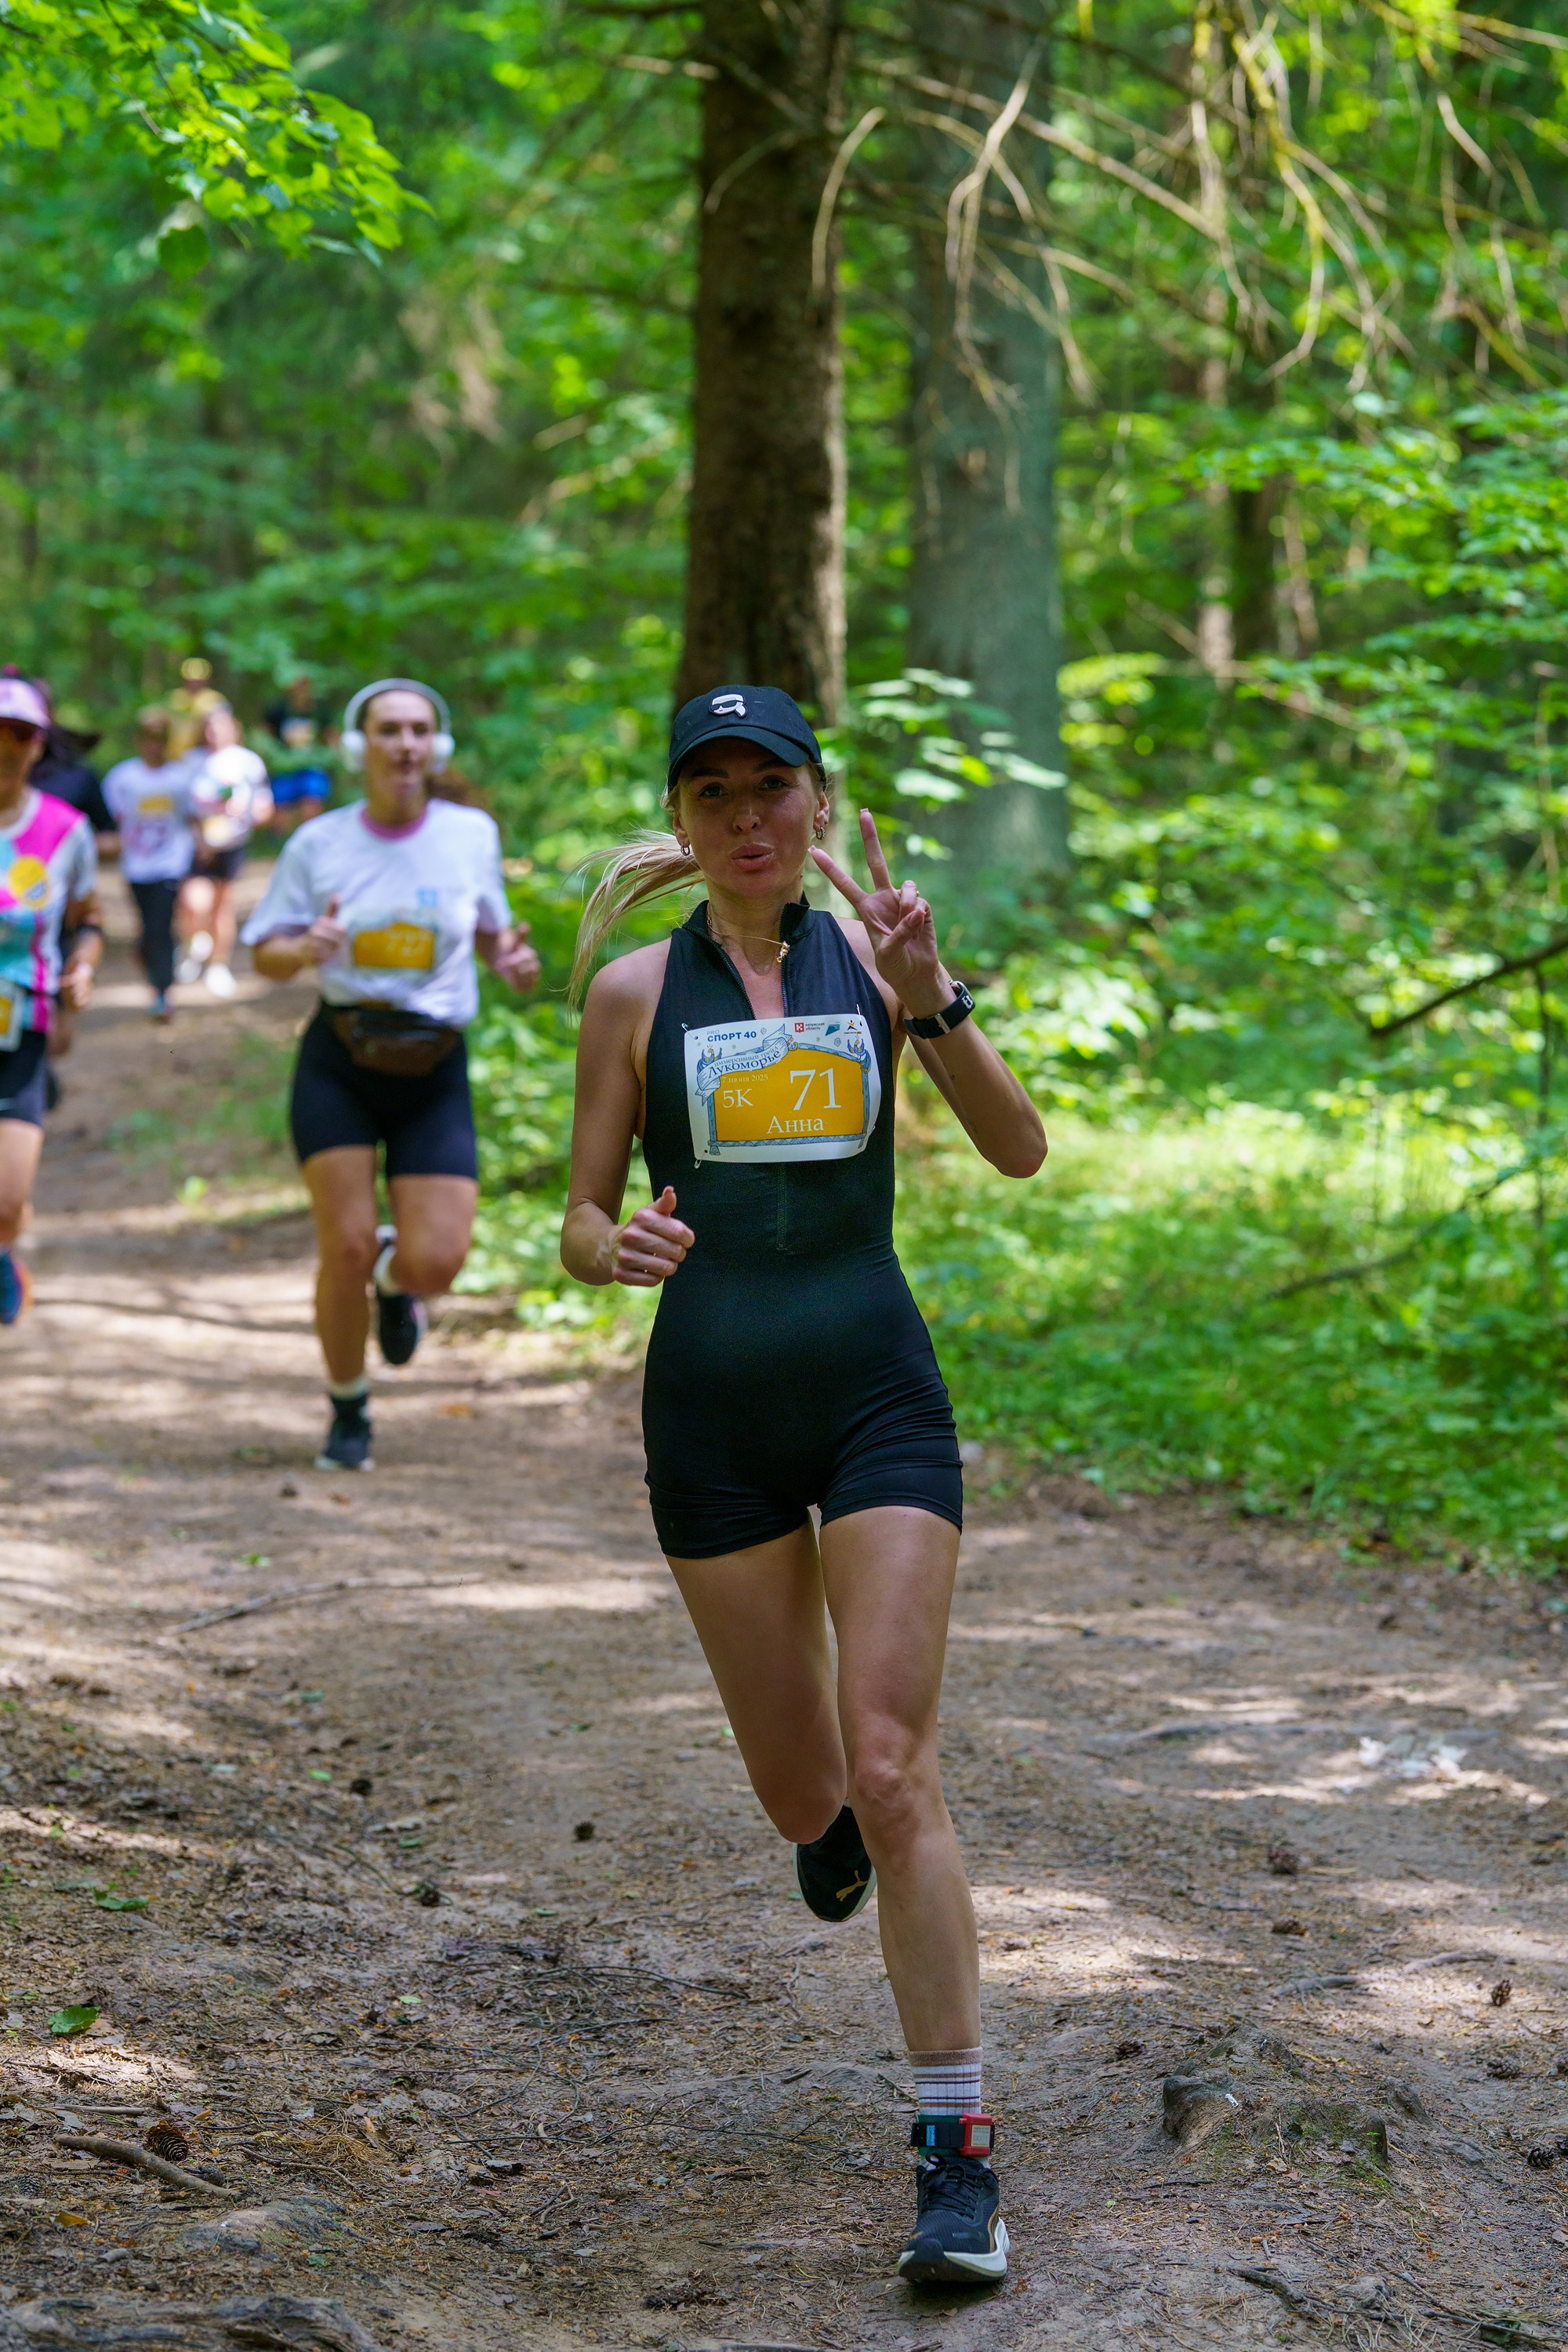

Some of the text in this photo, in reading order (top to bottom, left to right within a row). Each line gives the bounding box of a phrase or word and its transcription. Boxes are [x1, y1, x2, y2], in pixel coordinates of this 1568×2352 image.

[707, 1032, 742, 1042] СПОРТ
[708, 1051, 782, 1079] Лукоморье
[713, 1046, 779, 1067] иммерсивный трейл
[789, 1067, 841, 1111] 71
[766, 1115, 825, 1134] Анна
